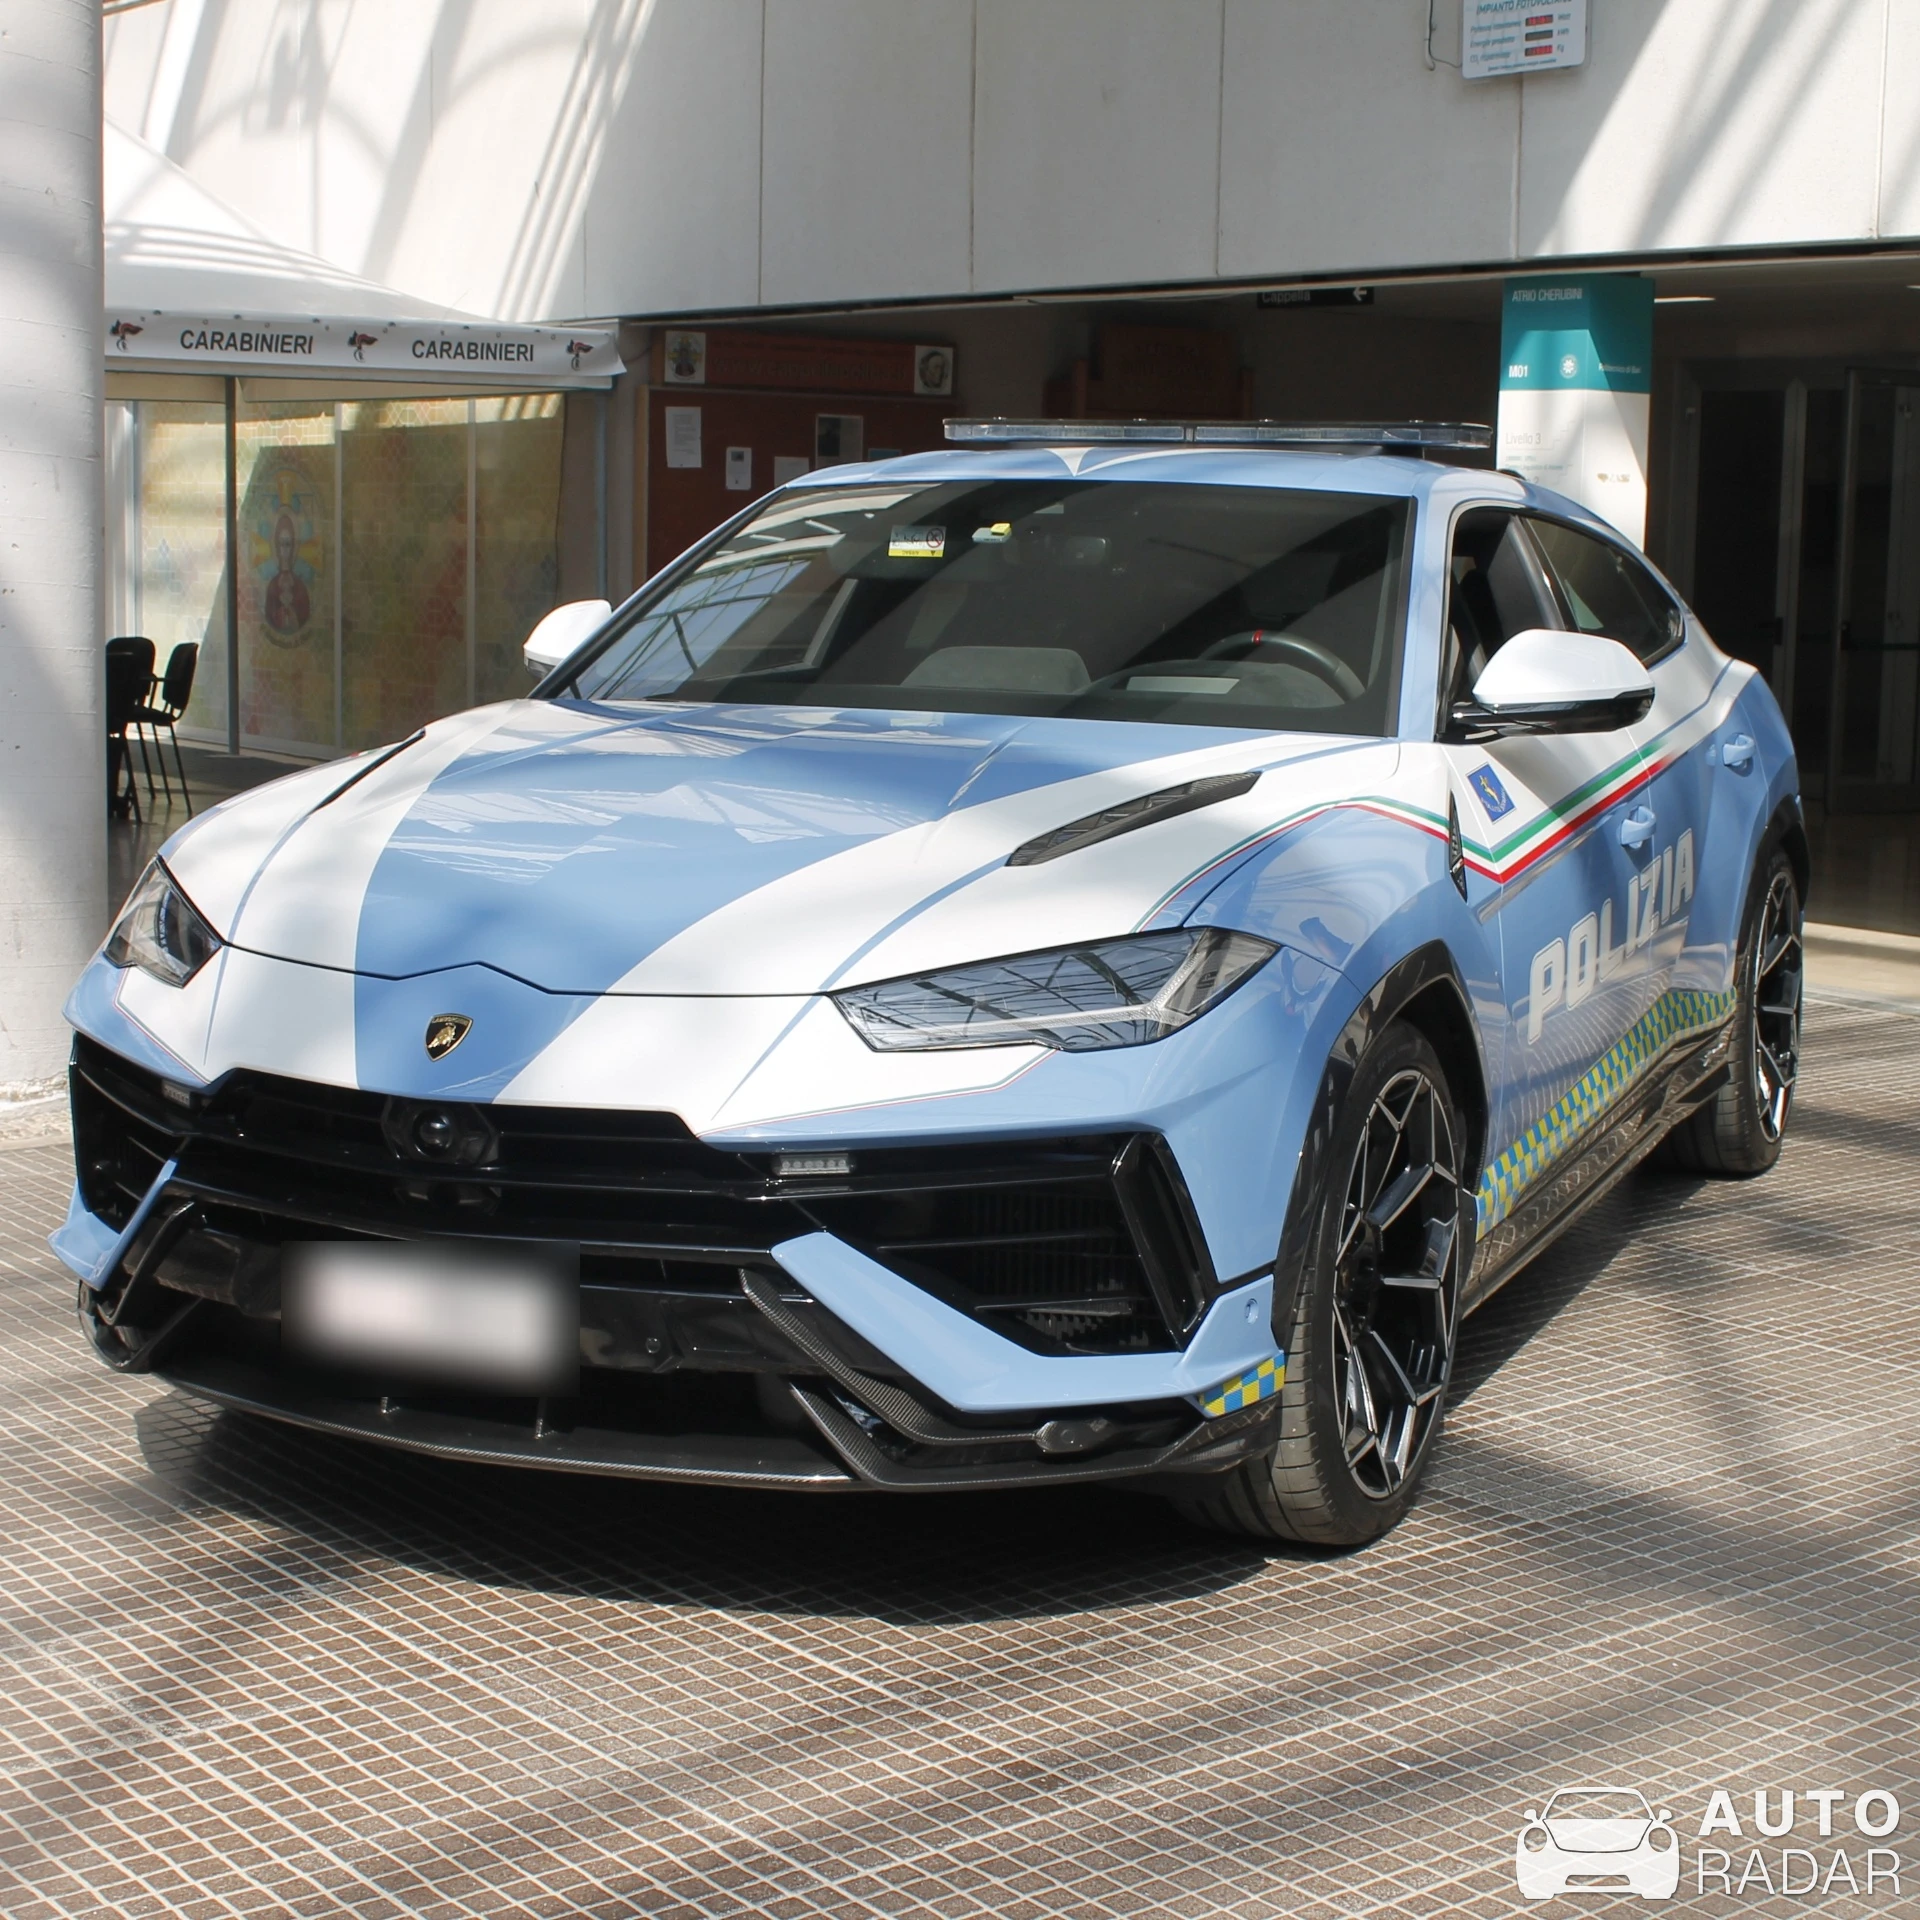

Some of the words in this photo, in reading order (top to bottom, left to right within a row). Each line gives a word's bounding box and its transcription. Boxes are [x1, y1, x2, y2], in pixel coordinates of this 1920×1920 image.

[1476, 0, 1514, 15] IMPIANTO
[1261, 289, 1311, 304] Cappella
[1511, 289, 1537, 302] ATRIO
[1537, 287, 1583, 301] CHERUBINI
[180, 328, 314, 356] CARABINIERI
[411, 339, 535, 363] CARABINIERI
[1508, 364, 1529, 378] M01
[1505, 432, 1534, 445] Livello
[1535, 432, 1542, 445] 3
[1527, 828, 1695, 1047] POLIZIA
